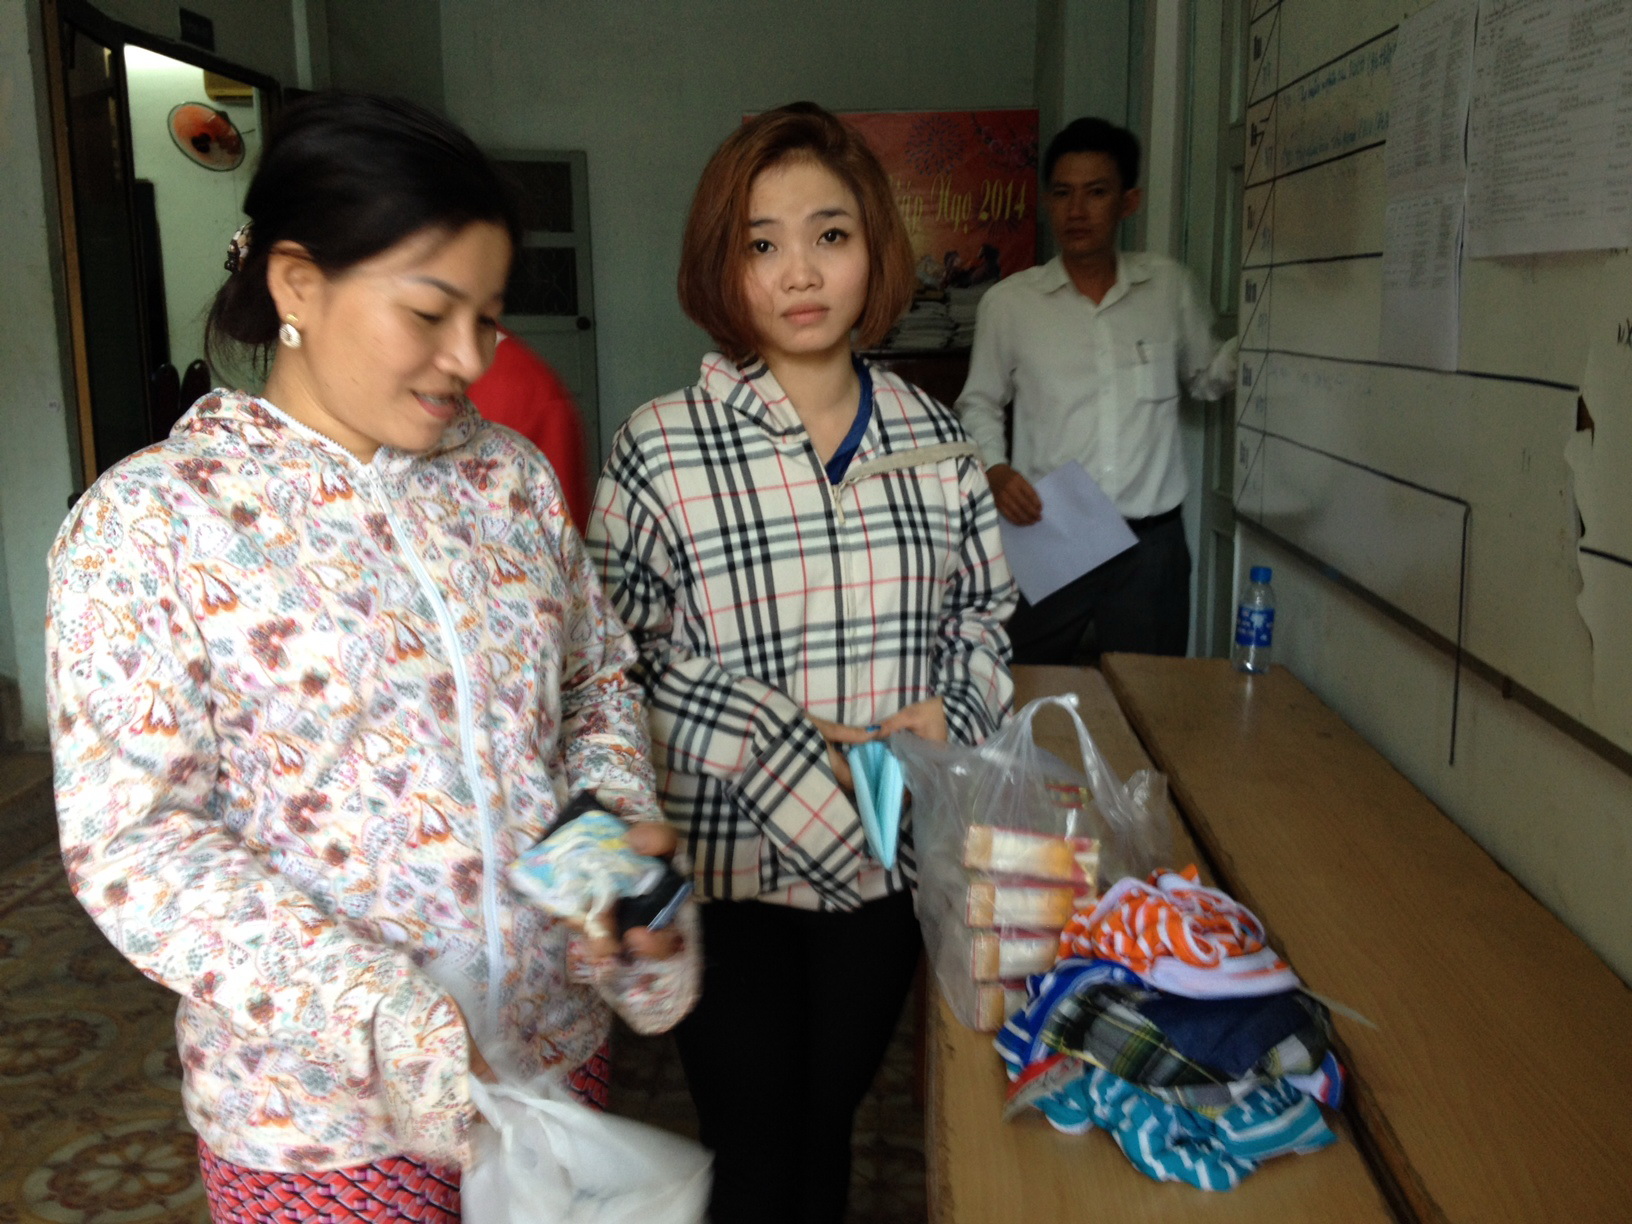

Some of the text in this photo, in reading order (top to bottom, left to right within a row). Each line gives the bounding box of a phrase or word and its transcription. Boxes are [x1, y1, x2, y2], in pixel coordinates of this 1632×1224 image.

[888, 172, 1027, 234] iáp Ngọ 2014
